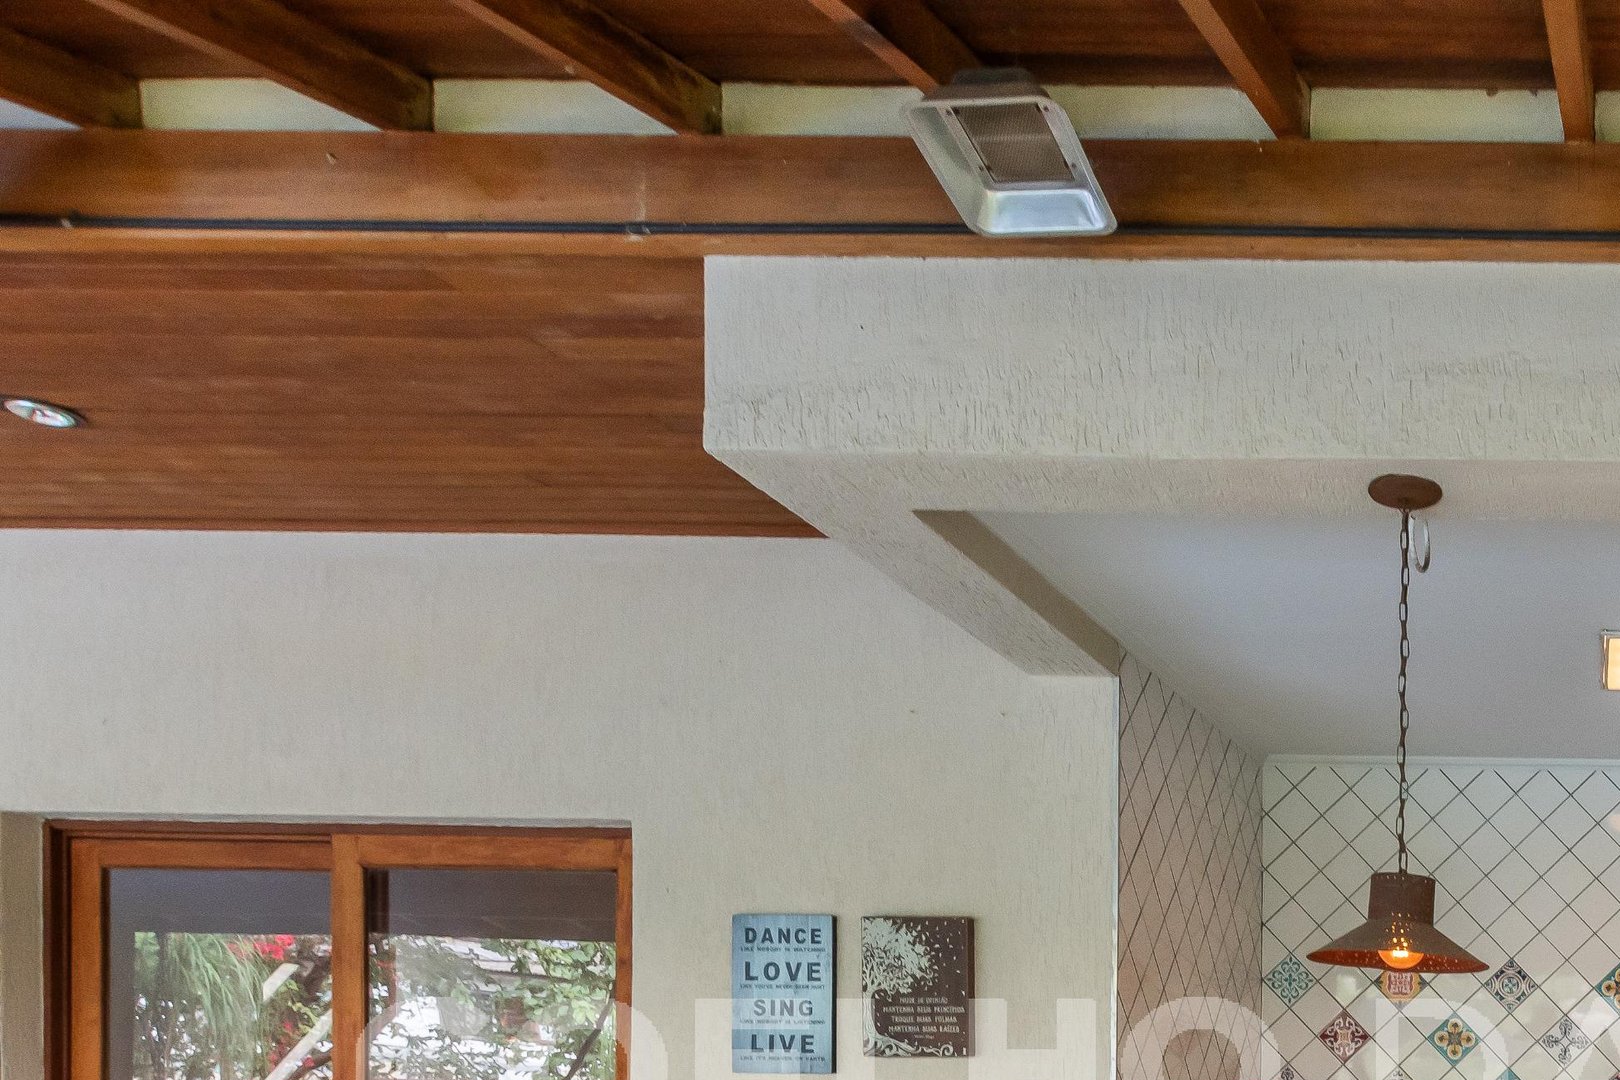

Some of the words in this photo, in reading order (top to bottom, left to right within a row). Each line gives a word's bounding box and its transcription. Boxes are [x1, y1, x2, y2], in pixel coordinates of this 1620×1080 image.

[744, 927, 822, 944] DANCE
[744, 961, 822, 981] LOVE
[753, 999, 814, 1017] SING
[751, 1034, 815, 1054] LIVE
